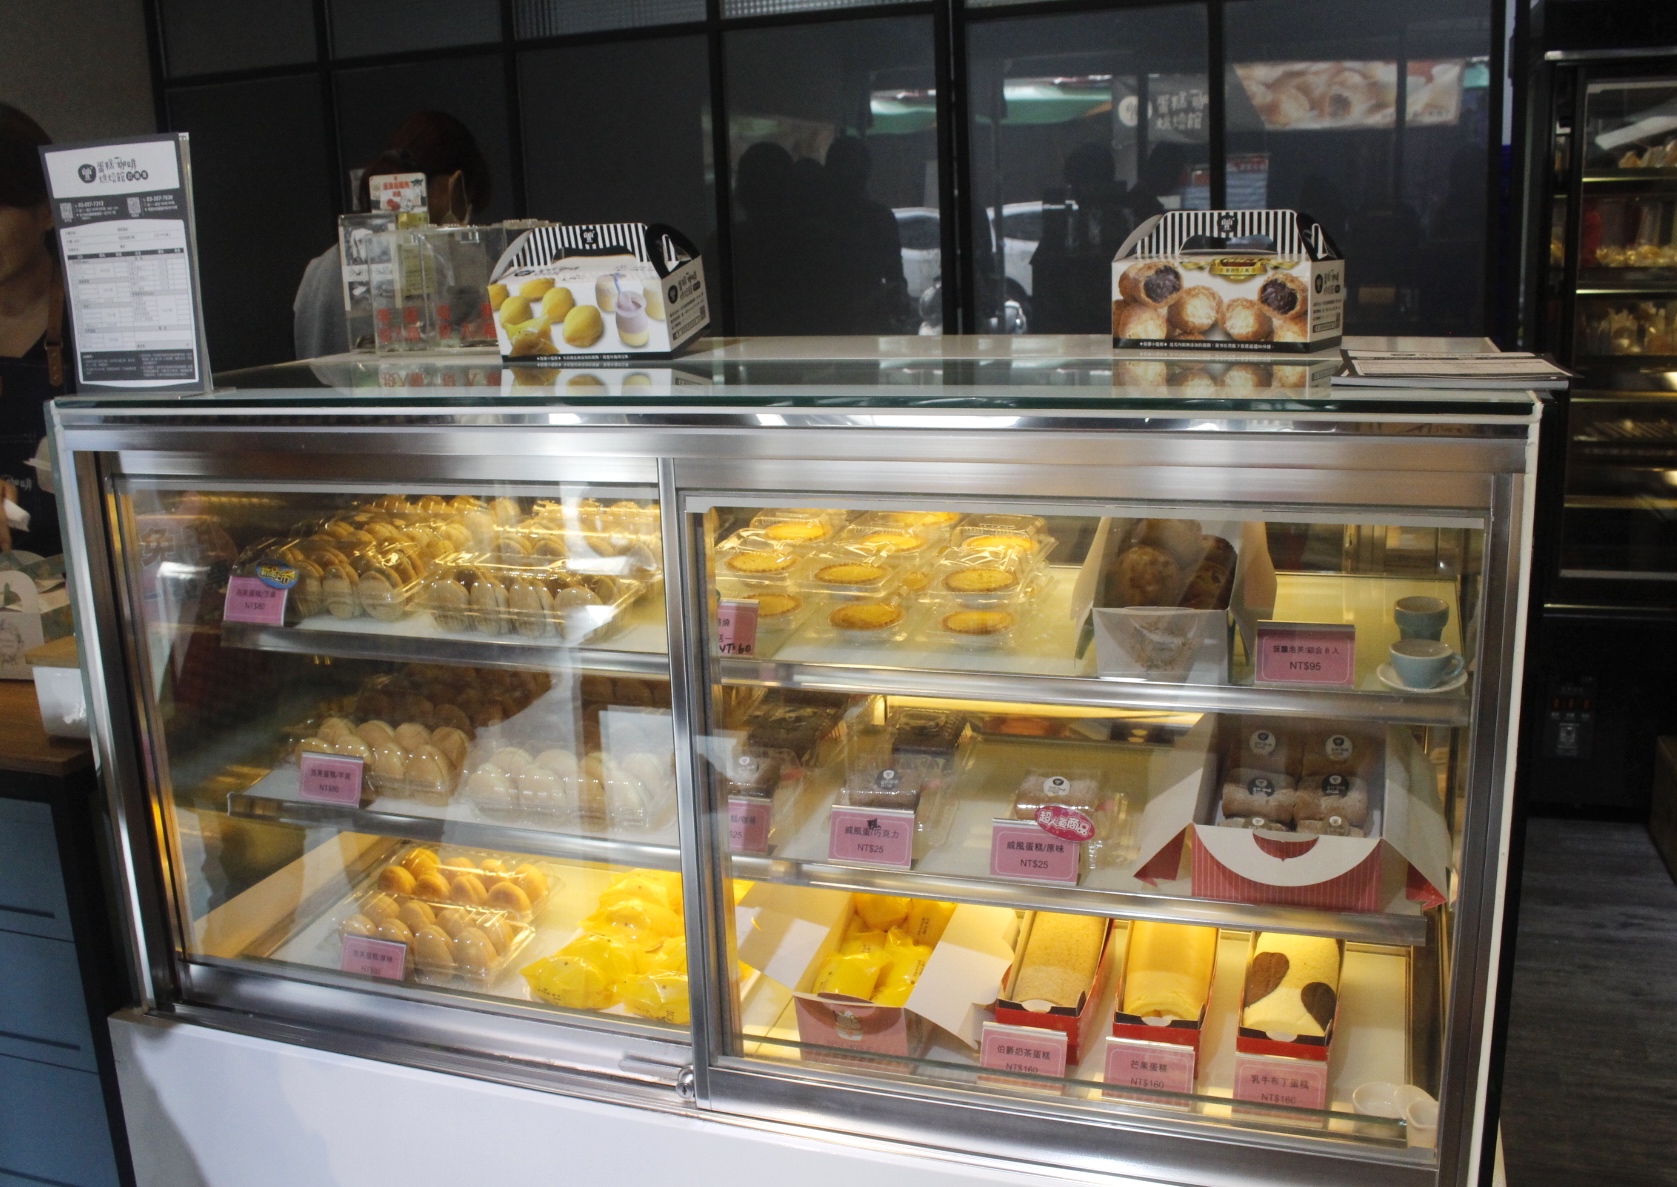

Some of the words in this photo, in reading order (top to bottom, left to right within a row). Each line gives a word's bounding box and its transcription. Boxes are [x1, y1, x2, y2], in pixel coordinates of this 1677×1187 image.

[1290, 661, 1321, 671] NT$95
[1038, 810, 1091, 837] 超人氣商品
[857, 843, 884, 854] NT$25
[1006, 840, 1065, 854] 戚風蛋糕/原味
[1020, 859, 1049, 869] NT$25
[997, 1044, 1051, 1060] 伯爵奶茶蛋糕
[1130, 1060, 1168, 1073] 芒果蛋糕
[1130, 1077, 1165, 1089] NT$160
[1250, 1074, 1310, 1090] 乳牛布丁蛋糕
